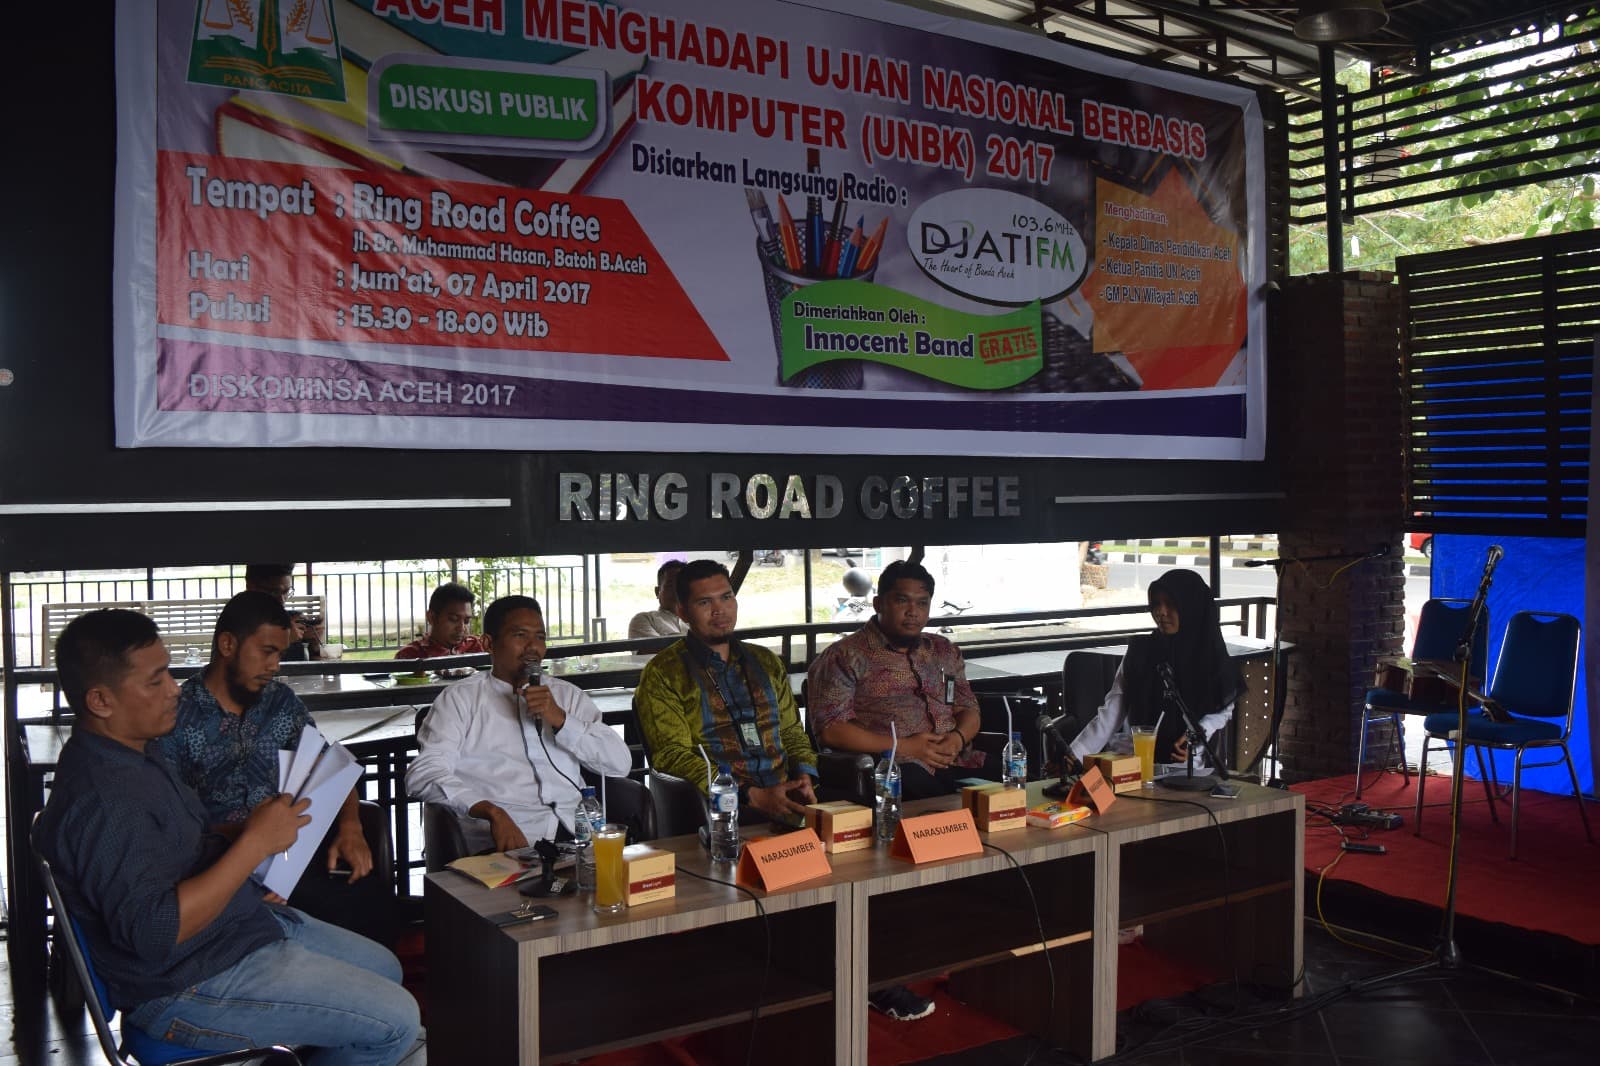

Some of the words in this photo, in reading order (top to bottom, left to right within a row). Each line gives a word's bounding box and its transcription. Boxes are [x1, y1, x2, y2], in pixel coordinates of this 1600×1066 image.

[377, 0, 502, 30] EH
[526, 0, 788, 79] MENGHADAPI
[807, 46, 909, 101] UJIAN
[924, 68, 1073, 132] NASIONAL
[1083, 102, 1206, 159] BERBASIS
[390, 83, 492, 115] DISKUSI
[501, 91, 589, 122] PUBLIK
[638, 79, 847, 149] KOMPUTER
[862, 115, 974, 179] (UNBK)
[987, 138, 1054, 183] 2017
[632, 143, 736, 184] Disiarkan
[743, 158, 837, 199] Langsung
[844, 173, 897, 204] Radio
[186, 165, 316, 220] Tempat
[353, 182, 422, 230] Ring
[431, 192, 506, 233] Road
[514, 199, 600, 243] Coffee
[372, 232, 398, 253] Dr.
[402, 235, 496, 262] Muhammad
[500, 243, 551, 268] Hasan,
[554, 248, 597, 271] Batoh
[600, 252, 648, 274] B.Aceh
[1109, 232, 1137, 252] Kepala
[1140, 236, 1164, 253] Dinas
[1167, 240, 1211, 258] Pendidikan
[1213, 247, 1232, 262] Aceh
[189, 251, 250, 281] Hari
[351, 262, 441, 298] Jum'at,
[447, 273, 476, 297] 07
[482, 272, 538, 303] April
[543, 280, 592, 305] 2017
[923, 257, 937, 272] The
[940, 260, 963, 274] Heart
[964, 263, 973, 279] of
[1107, 259, 1132, 275] Ketua
[1135, 261, 1163, 278] Panitia
[1165, 264, 1178, 279] UN
[1181, 267, 1201, 281] Aceh
[794, 301, 884, 322] Dimeriahkan
[889, 308, 918, 324] Oleh
[1105, 286, 1120, 302] GM
[1122, 287, 1141, 302] PLN
[1143, 288, 1176, 307] Wilayah
[1178, 290, 1199, 305] Aceh
[189, 291, 271, 323] Pukul
[351, 304, 412, 330] 15.30
[436, 309, 497, 335] 18.00
[503, 311, 549, 339] Wib
[805, 325, 908, 354] Innocent
[915, 332, 974, 357] Band
[979, 332, 1038, 359] GRATIS
[188, 373, 374, 401] DISKOMINSA
[379, 380, 452, 404] ACEH
[461, 383, 517, 406] 2017
[559, 472, 688, 521] RING
[711, 472, 844, 520] ROAD
[860, 474, 1021, 521] COFFEE
[913, 822, 969, 840] NARASUMBER
[761, 841, 816, 865] NARASUMBER
